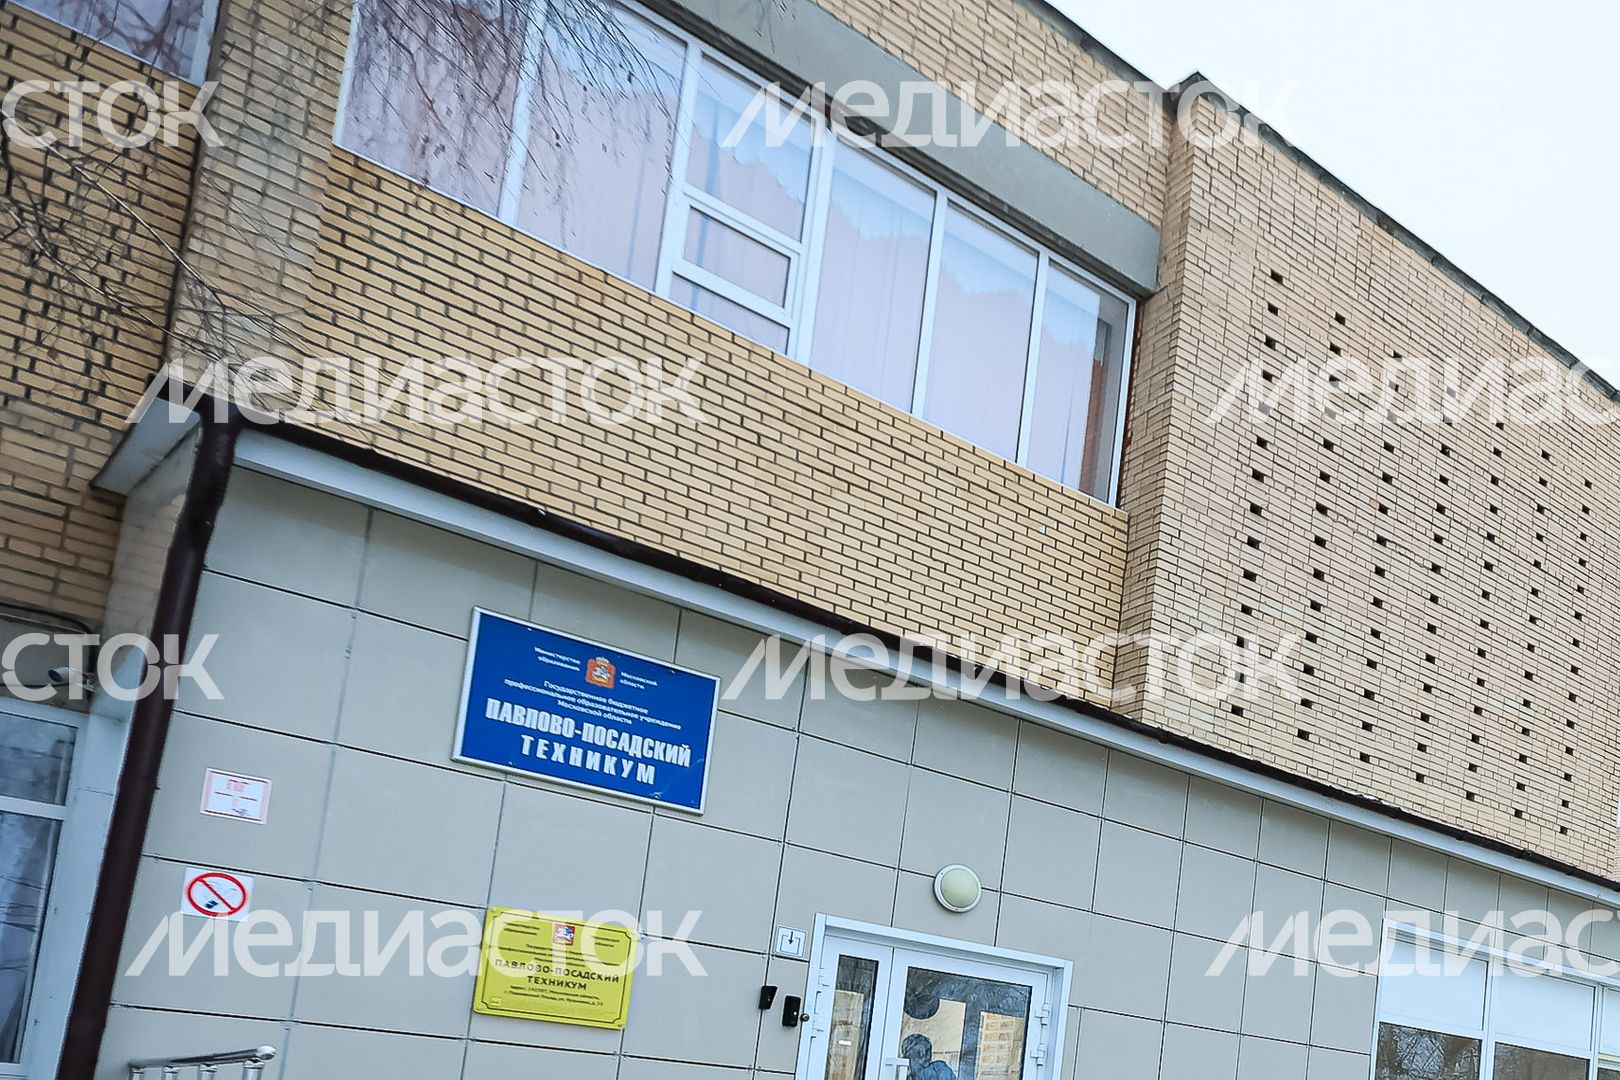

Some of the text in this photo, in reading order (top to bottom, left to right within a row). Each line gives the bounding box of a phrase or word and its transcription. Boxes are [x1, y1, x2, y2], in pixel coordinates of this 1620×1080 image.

[485, 698, 692, 768] ПАВЛОВО-ПОСАДСКИЙ
[521, 734, 656, 785] ТЕХНИКУМ
[495, 958, 620, 983] ПАВЛОВО-ПОСАДСКИЙ
[527, 975, 587, 990] ТЕХНИКУМ
